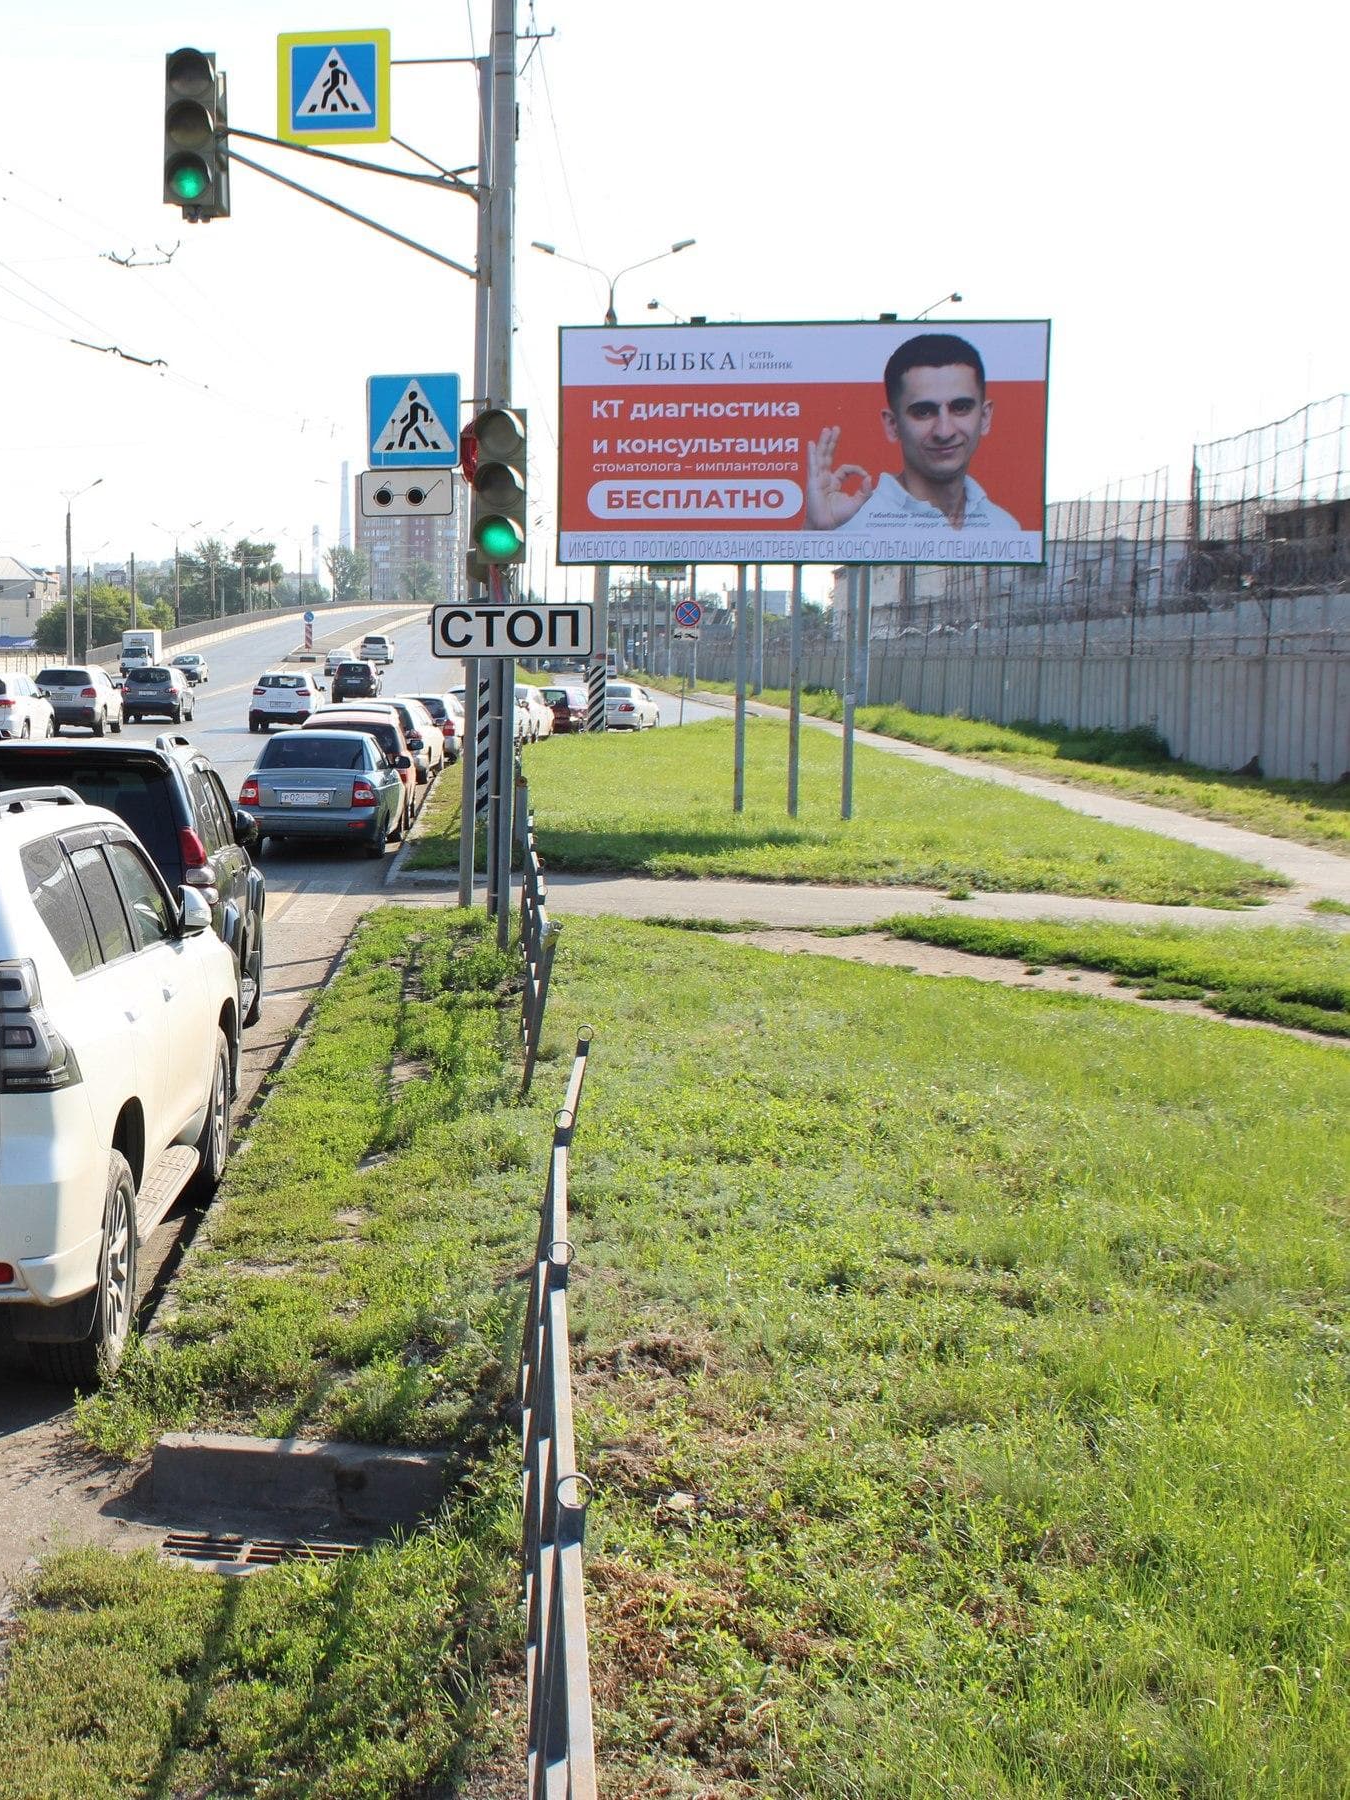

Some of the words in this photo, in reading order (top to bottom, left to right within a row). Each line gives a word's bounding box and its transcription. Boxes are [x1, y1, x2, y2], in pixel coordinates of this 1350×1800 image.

[620, 351, 737, 371] УЛЫБКА
[748, 360, 794, 370] клиник
[592, 400, 624, 418] КТ
[630, 401, 800, 420] диагностика
[592, 439, 608, 454] и
[616, 437, 799, 458] консультация
[592, 462, 682, 473] стоматолога
[695, 461, 799, 472] имплантолога
[606, 489, 785, 509] БЕСПЛАТНО
[568, 540, 627, 559] ИМЕЮТСЯ
[837, 540, 934, 559] КОНСУЛЬТАЦИЯ
[440, 610, 580, 648] СТОП
